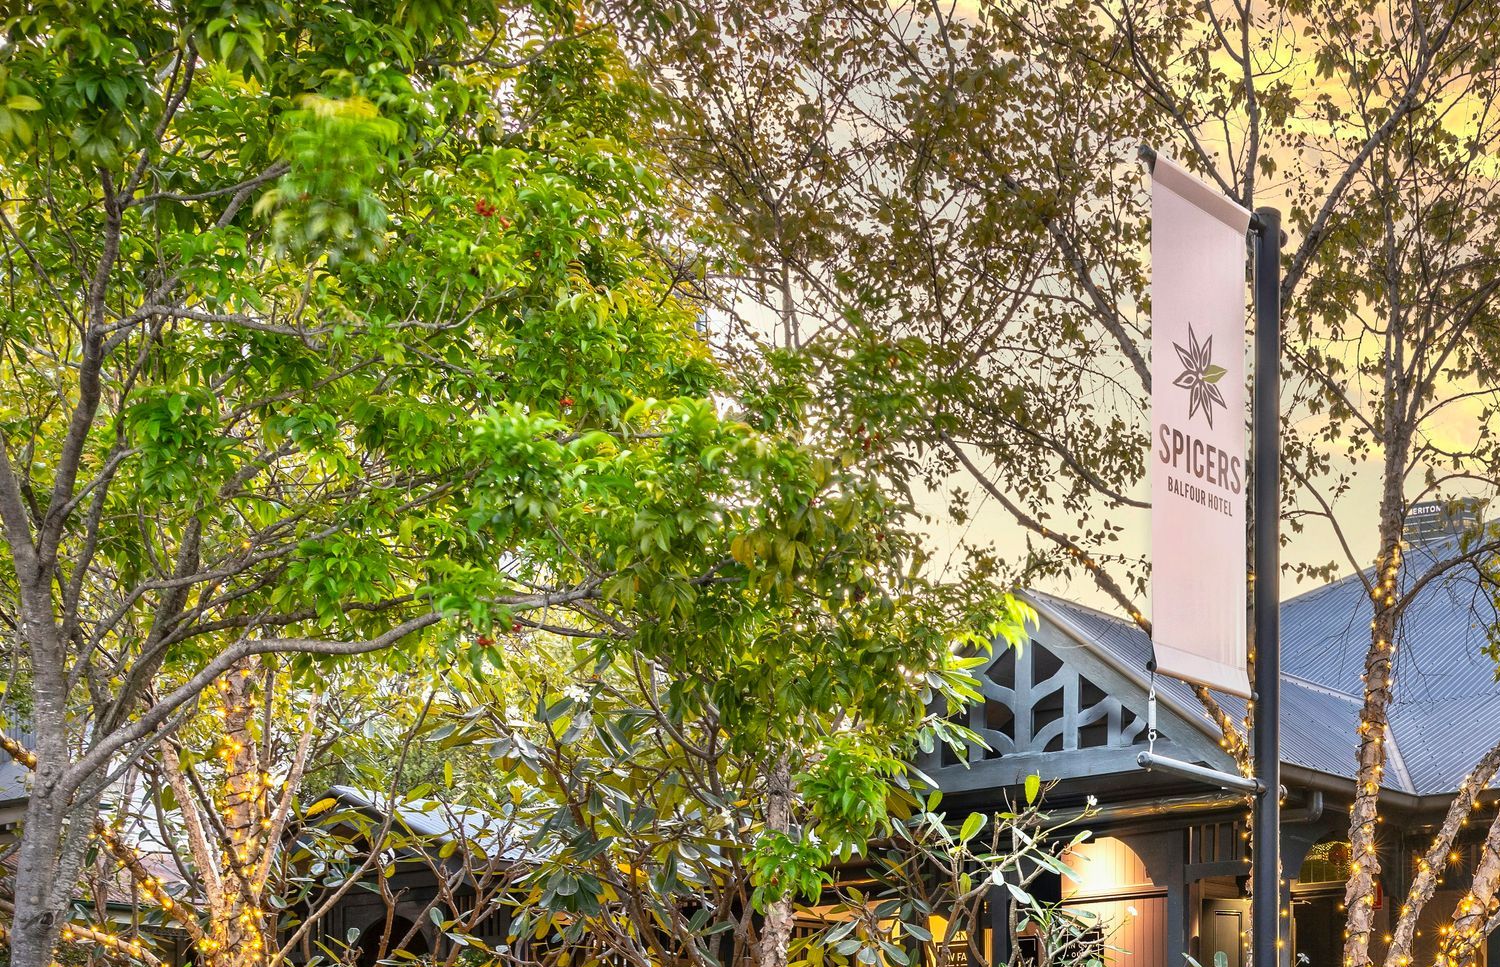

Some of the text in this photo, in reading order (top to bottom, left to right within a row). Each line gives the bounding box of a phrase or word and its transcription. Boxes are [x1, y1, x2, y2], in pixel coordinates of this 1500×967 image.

[1158, 423, 1241, 495] SPICERS
[1167, 475, 1233, 517] BALFOUR HOTEL
[1408, 505, 1441, 515] ERITON
